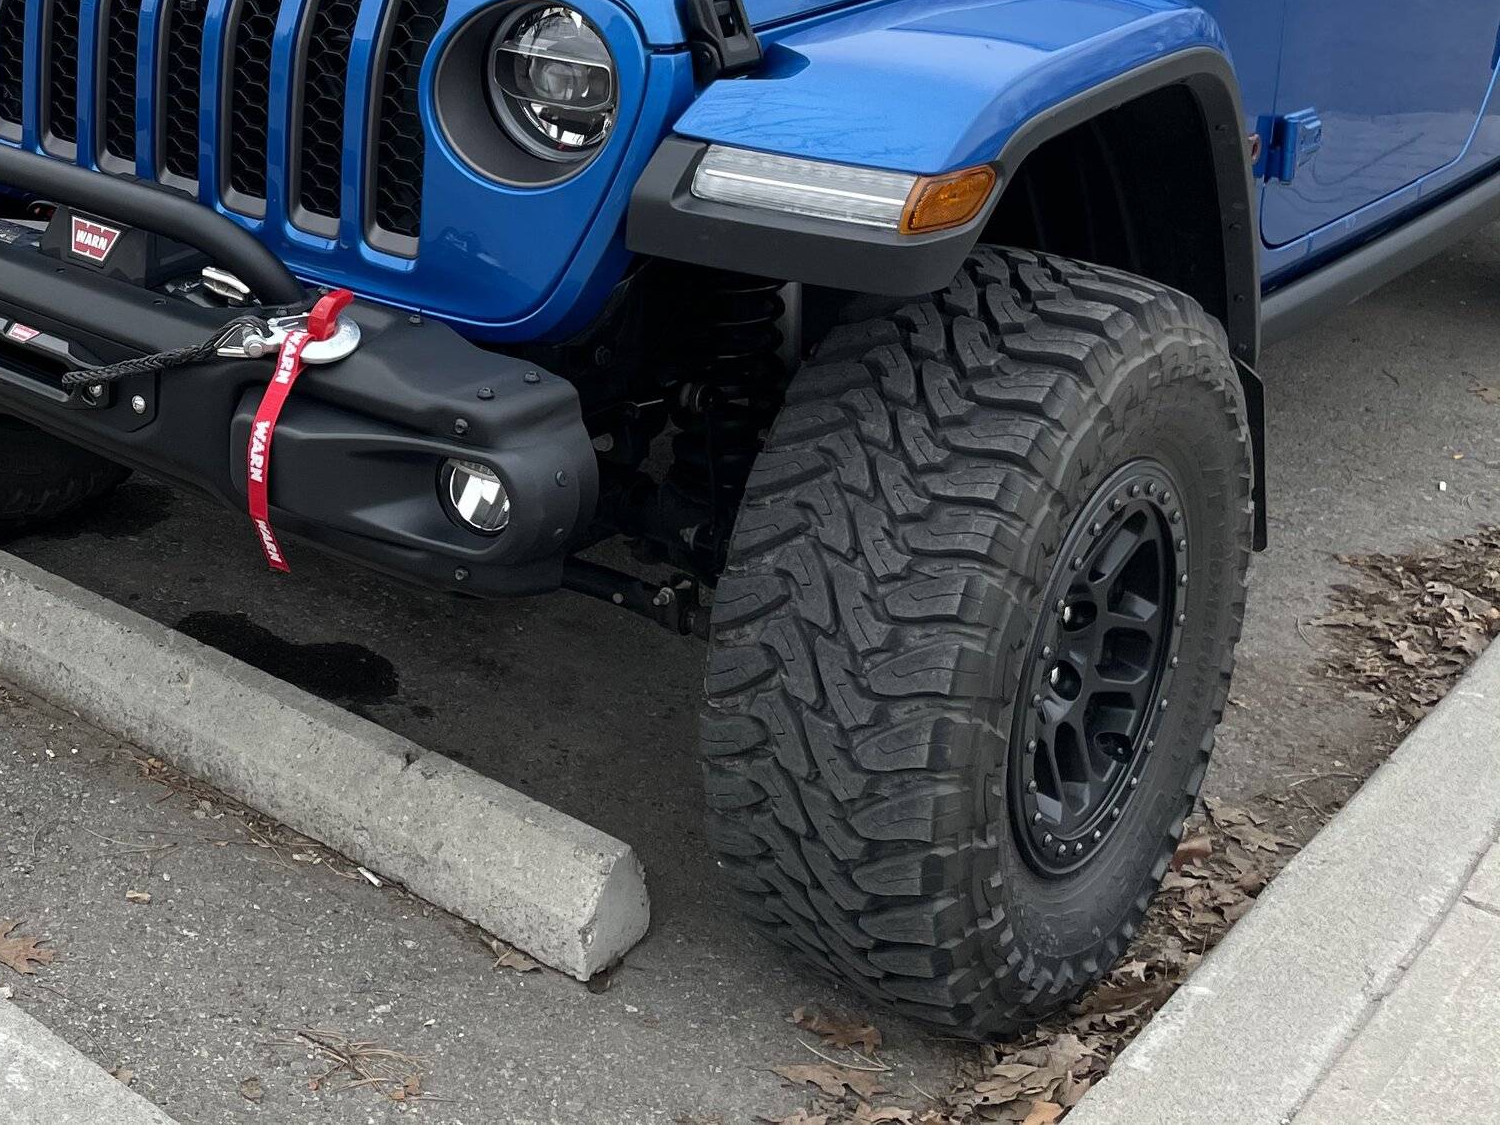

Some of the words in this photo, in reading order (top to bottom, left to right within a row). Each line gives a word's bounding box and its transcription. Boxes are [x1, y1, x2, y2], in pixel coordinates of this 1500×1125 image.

[76, 229, 107, 251] WARN
[275, 332, 306, 384] WARN
[250, 420, 270, 483] WARN
[255, 519, 282, 563] WARN
